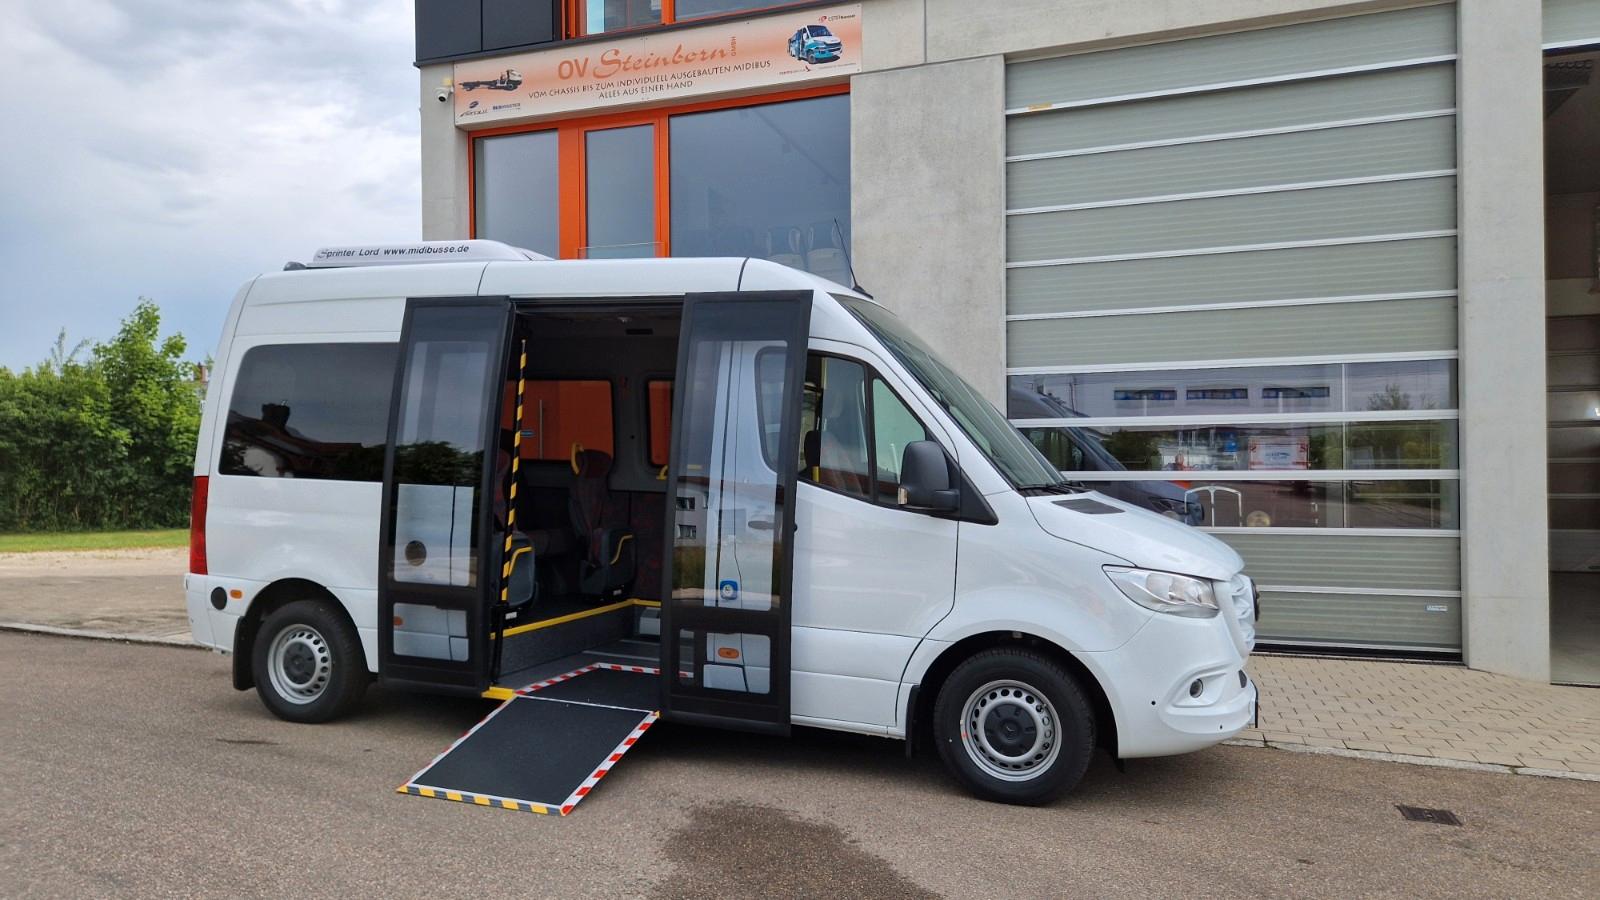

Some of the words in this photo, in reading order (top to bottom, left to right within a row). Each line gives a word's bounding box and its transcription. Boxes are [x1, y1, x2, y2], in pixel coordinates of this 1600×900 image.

[558, 57, 589, 80] OV
[593, 43, 727, 79] Steinborn
[528, 92, 548, 100] VOM
[550, 86, 580, 96] CHASSIS
[583, 84, 594, 92] BIS
[595, 80, 615, 91] ZUM
[617, 74, 668, 87] INDIVIDUELL
[670, 65, 731, 80] AUSGEBAUTEN
[733, 60, 771, 72] MIDIBUS
[599, 91, 621, 99] ALLES
[622, 87, 639, 96] AUS
[641, 84, 664, 93] EINER
[667, 80, 693, 90] HAND
[317, 249, 355, 259] Sprinter
[358, 248, 379, 256] Lord
[383, 245, 469, 255] www.midibusse.de
